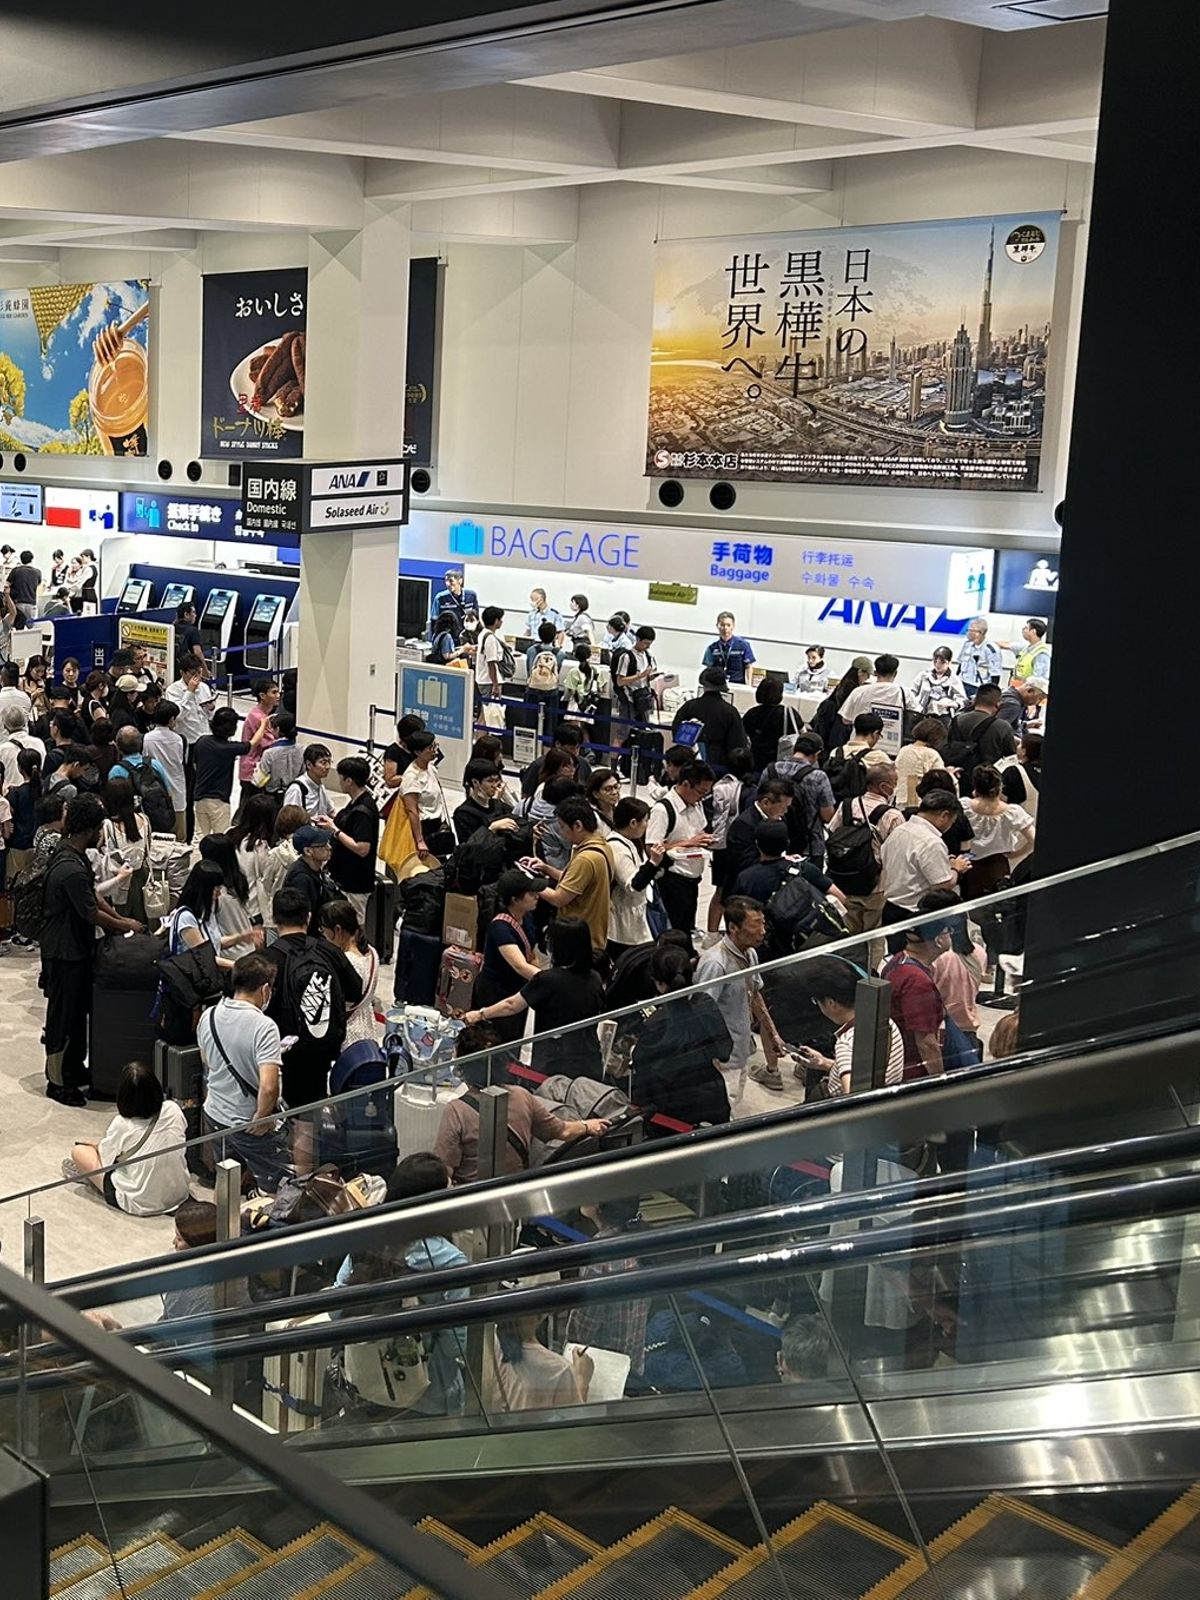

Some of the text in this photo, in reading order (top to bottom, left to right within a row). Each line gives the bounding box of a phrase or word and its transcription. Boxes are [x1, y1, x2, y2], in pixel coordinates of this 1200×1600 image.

[837, 248, 874, 356] 日本の
[721, 253, 770, 399] 世界へ。
[774, 250, 825, 398] 黒樺牛
[683, 451, 738, 470] 杉本本店
[247, 478, 297, 501] 国内線
[329, 473, 357, 490] ANA
[247, 501, 287, 515] Domestic
[325, 503, 379, 519] Solaseed Air
[491, 525, 641, 568] BAGGAGE
[711, 541, 774, 566] 手荷物
[802, 550, 854, 567] 行李托运
[710, 564, 770, 583] Baggage
[801, 571, 875, 590] 수화물 수속
[818, 598, 926, 631] ANA
